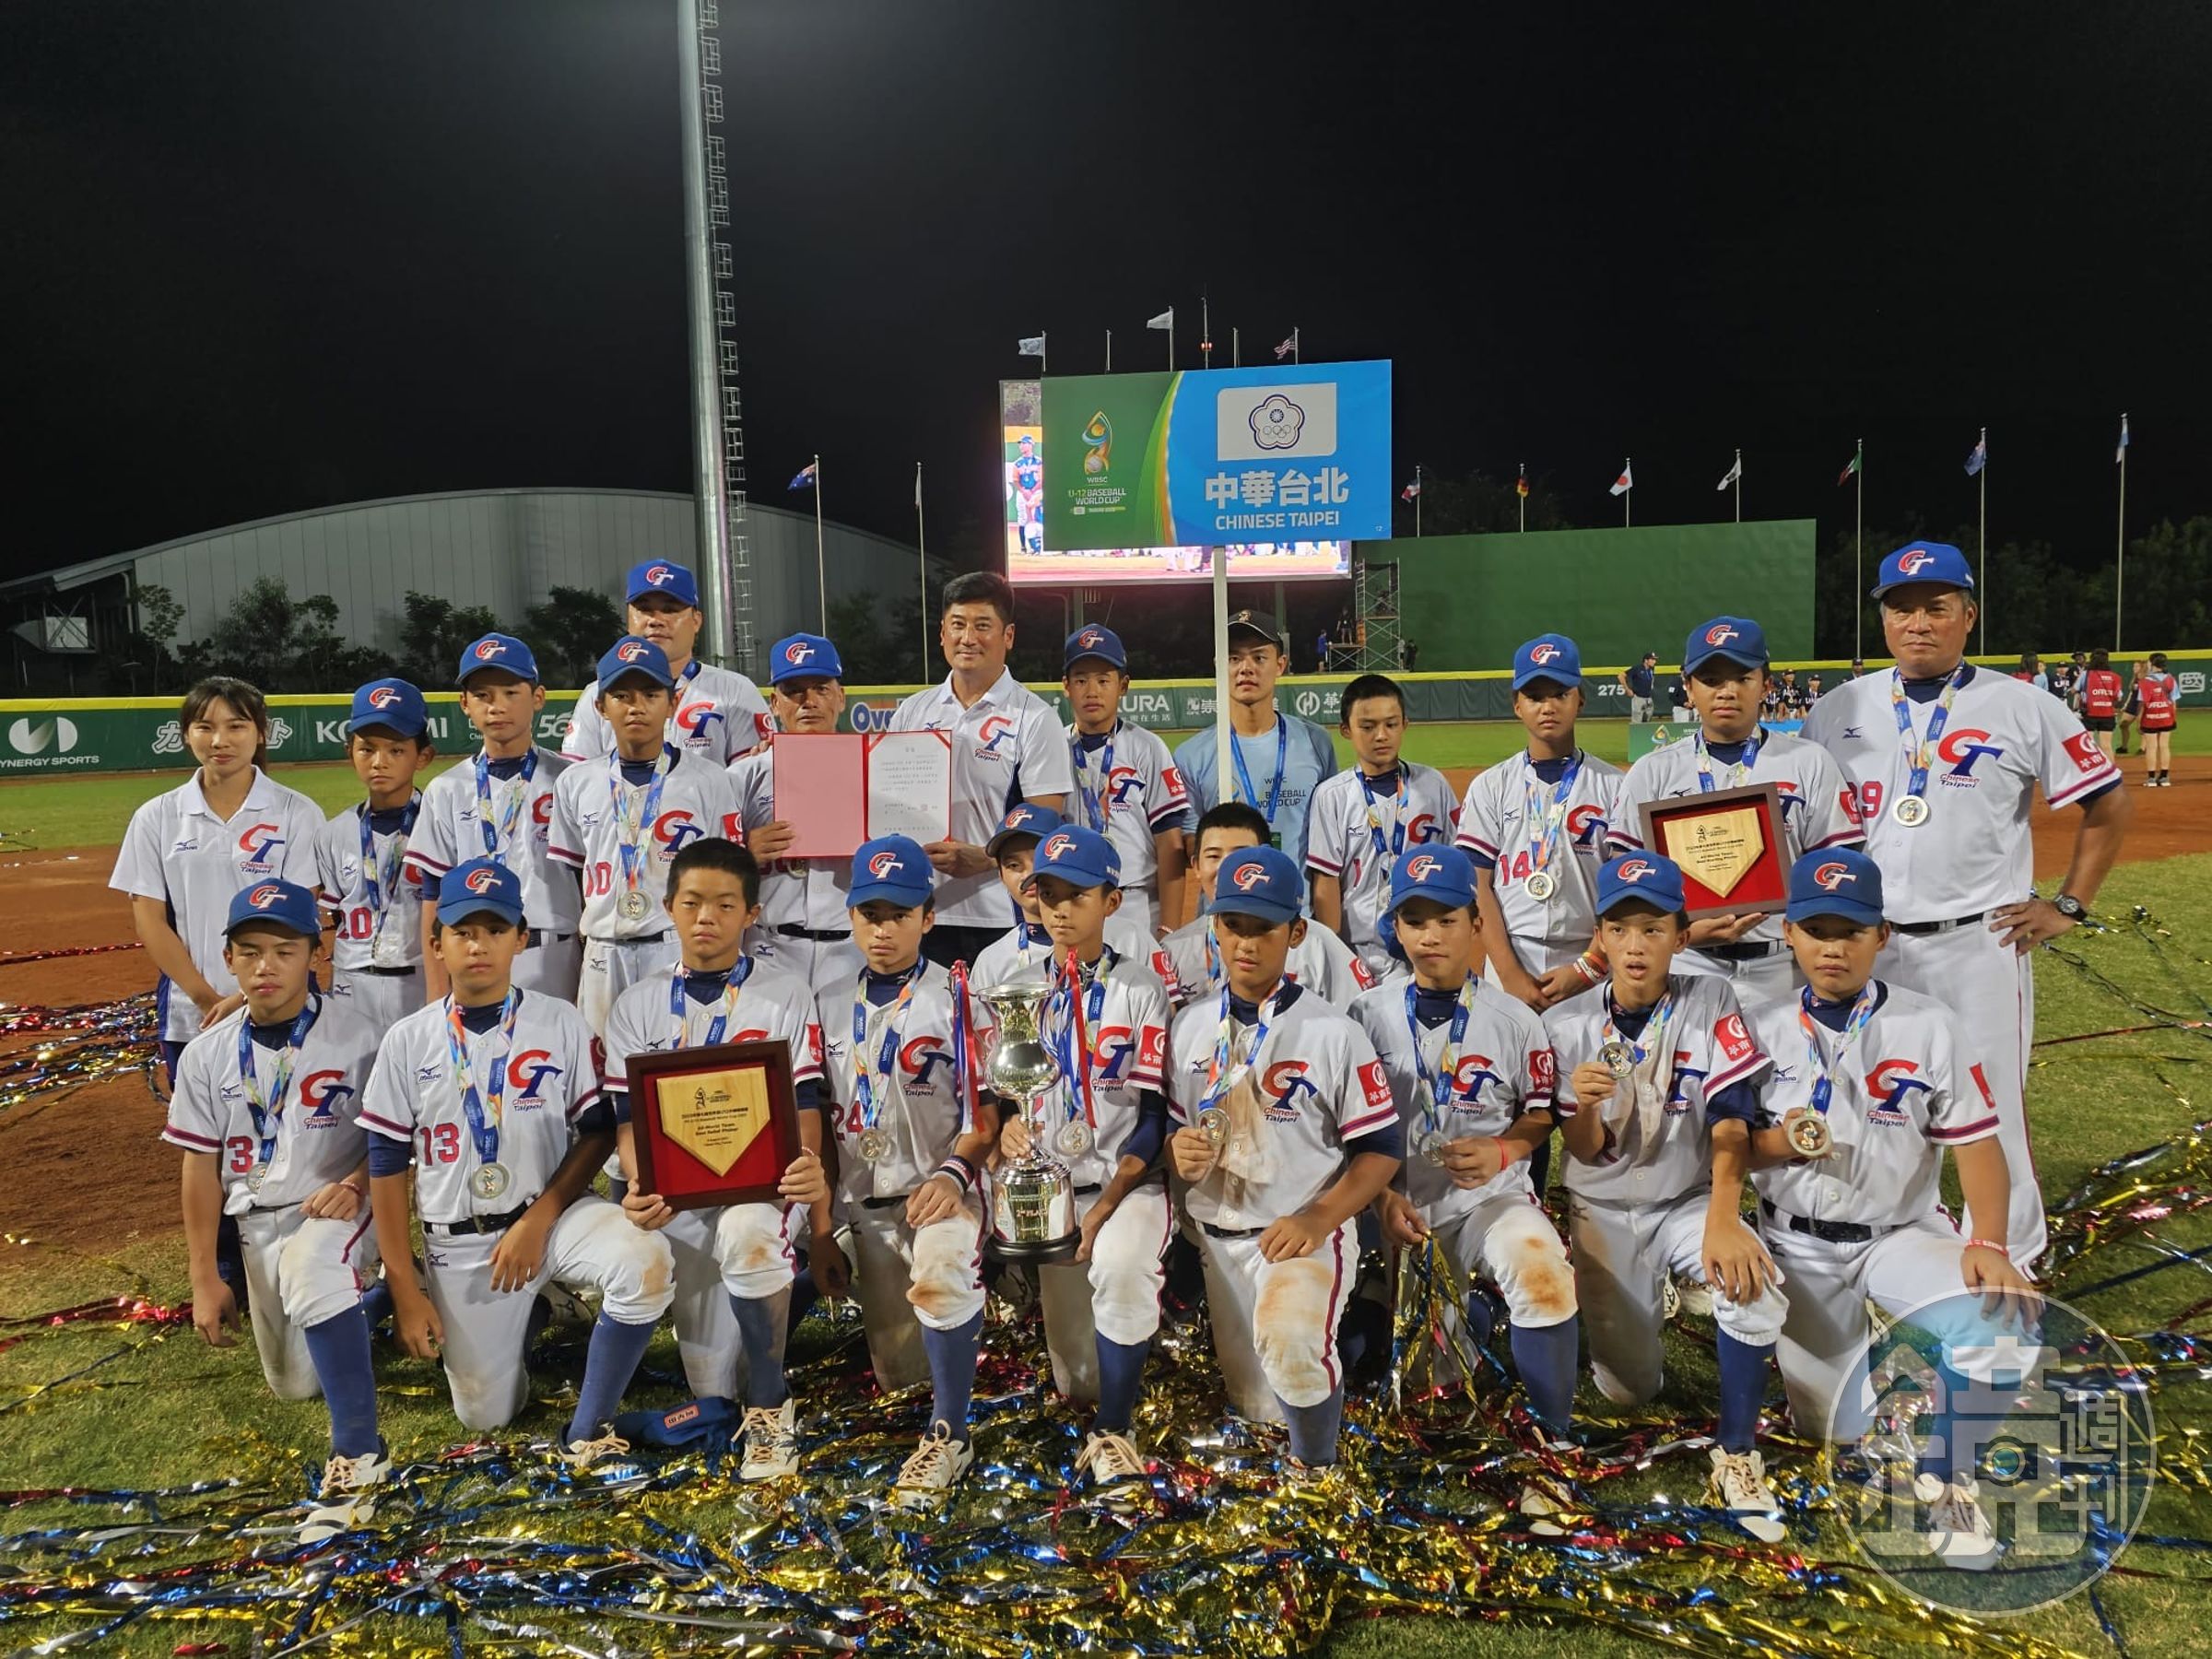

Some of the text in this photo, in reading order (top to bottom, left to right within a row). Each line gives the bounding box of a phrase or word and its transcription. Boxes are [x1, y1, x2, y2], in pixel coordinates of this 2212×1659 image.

[1068, 488, 1126, 498] U-12 BASEBALL
[1205, 466, 1349, 510] 中華台北
[1076, 496, 1121, 505] WORLD CUP
[1215, 511, 1340, 531] CHINESE TAIPEI
[1597, 685, 1625, 697] 275
[52, 755, 100, 765] SPORTS
[1939, 772, 1981, 783] Chinese
[1938, 779, 1977, 789] Taipei
[1265, 789, 1307, 799] BSEBALL
[239, 862, 274, 870] Chinese
[241, 866, 272, 875] Taipei
[1499, 851, 1532, 886] 14
[1264, 1106, 1300, 1117] Chinese
[1452, 1106, 1484, 1115] Taipei
[1866, 1110, 1910, 1121] Chinese
[1264, 1113, 1298, 1124] Taipei
[1867, 1117, 1906, 1127] Taipei
[419, 1122, 460, 1166] 13
[226, 1135, 253, 1173] 3
